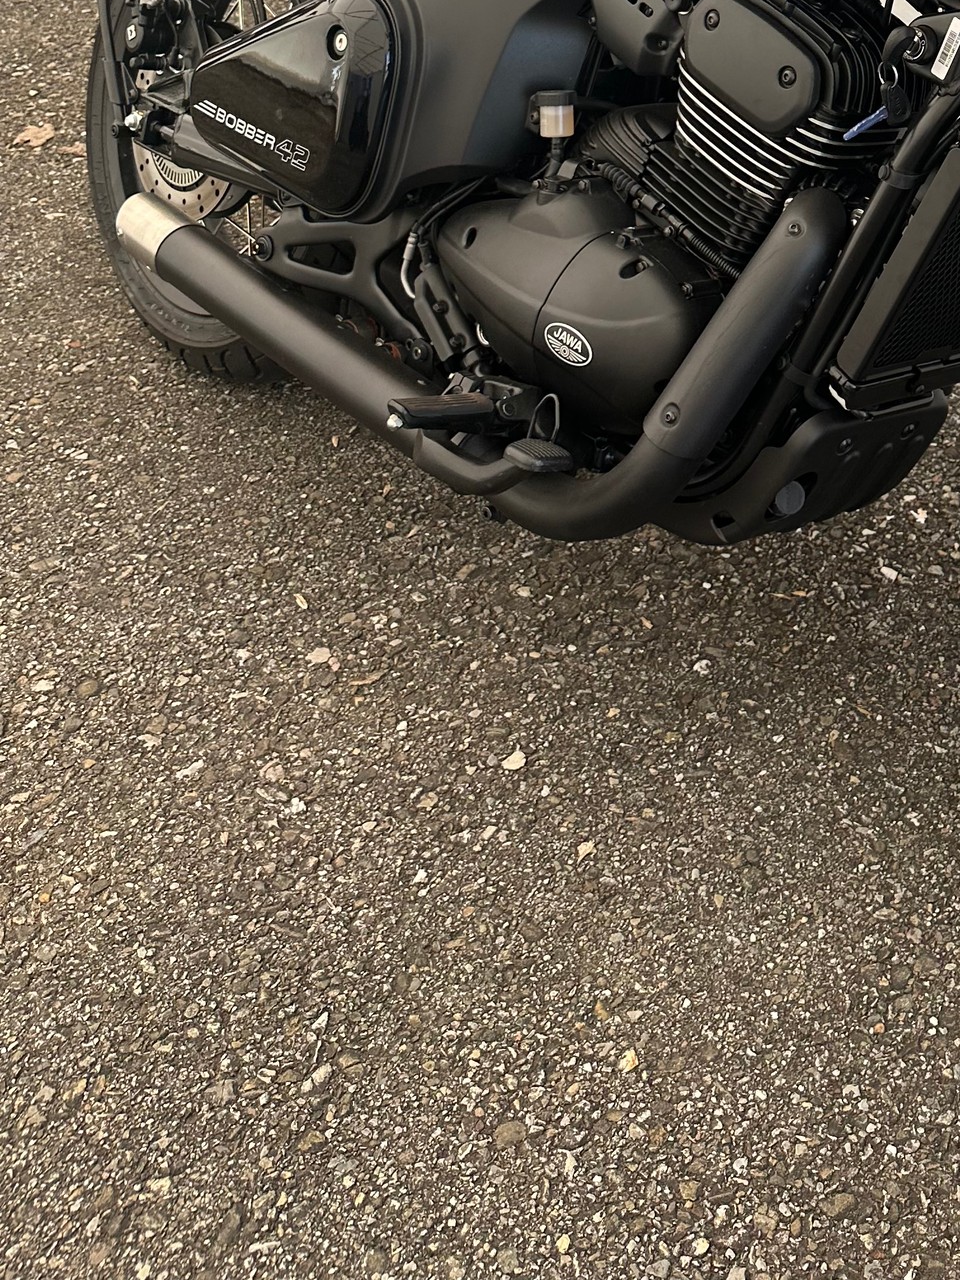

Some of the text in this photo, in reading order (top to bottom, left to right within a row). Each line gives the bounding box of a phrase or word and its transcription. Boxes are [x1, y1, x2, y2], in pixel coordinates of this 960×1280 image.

[215, 107, 311, 171] BOBBER 42
[553, 327, 583, 353] JAWA
